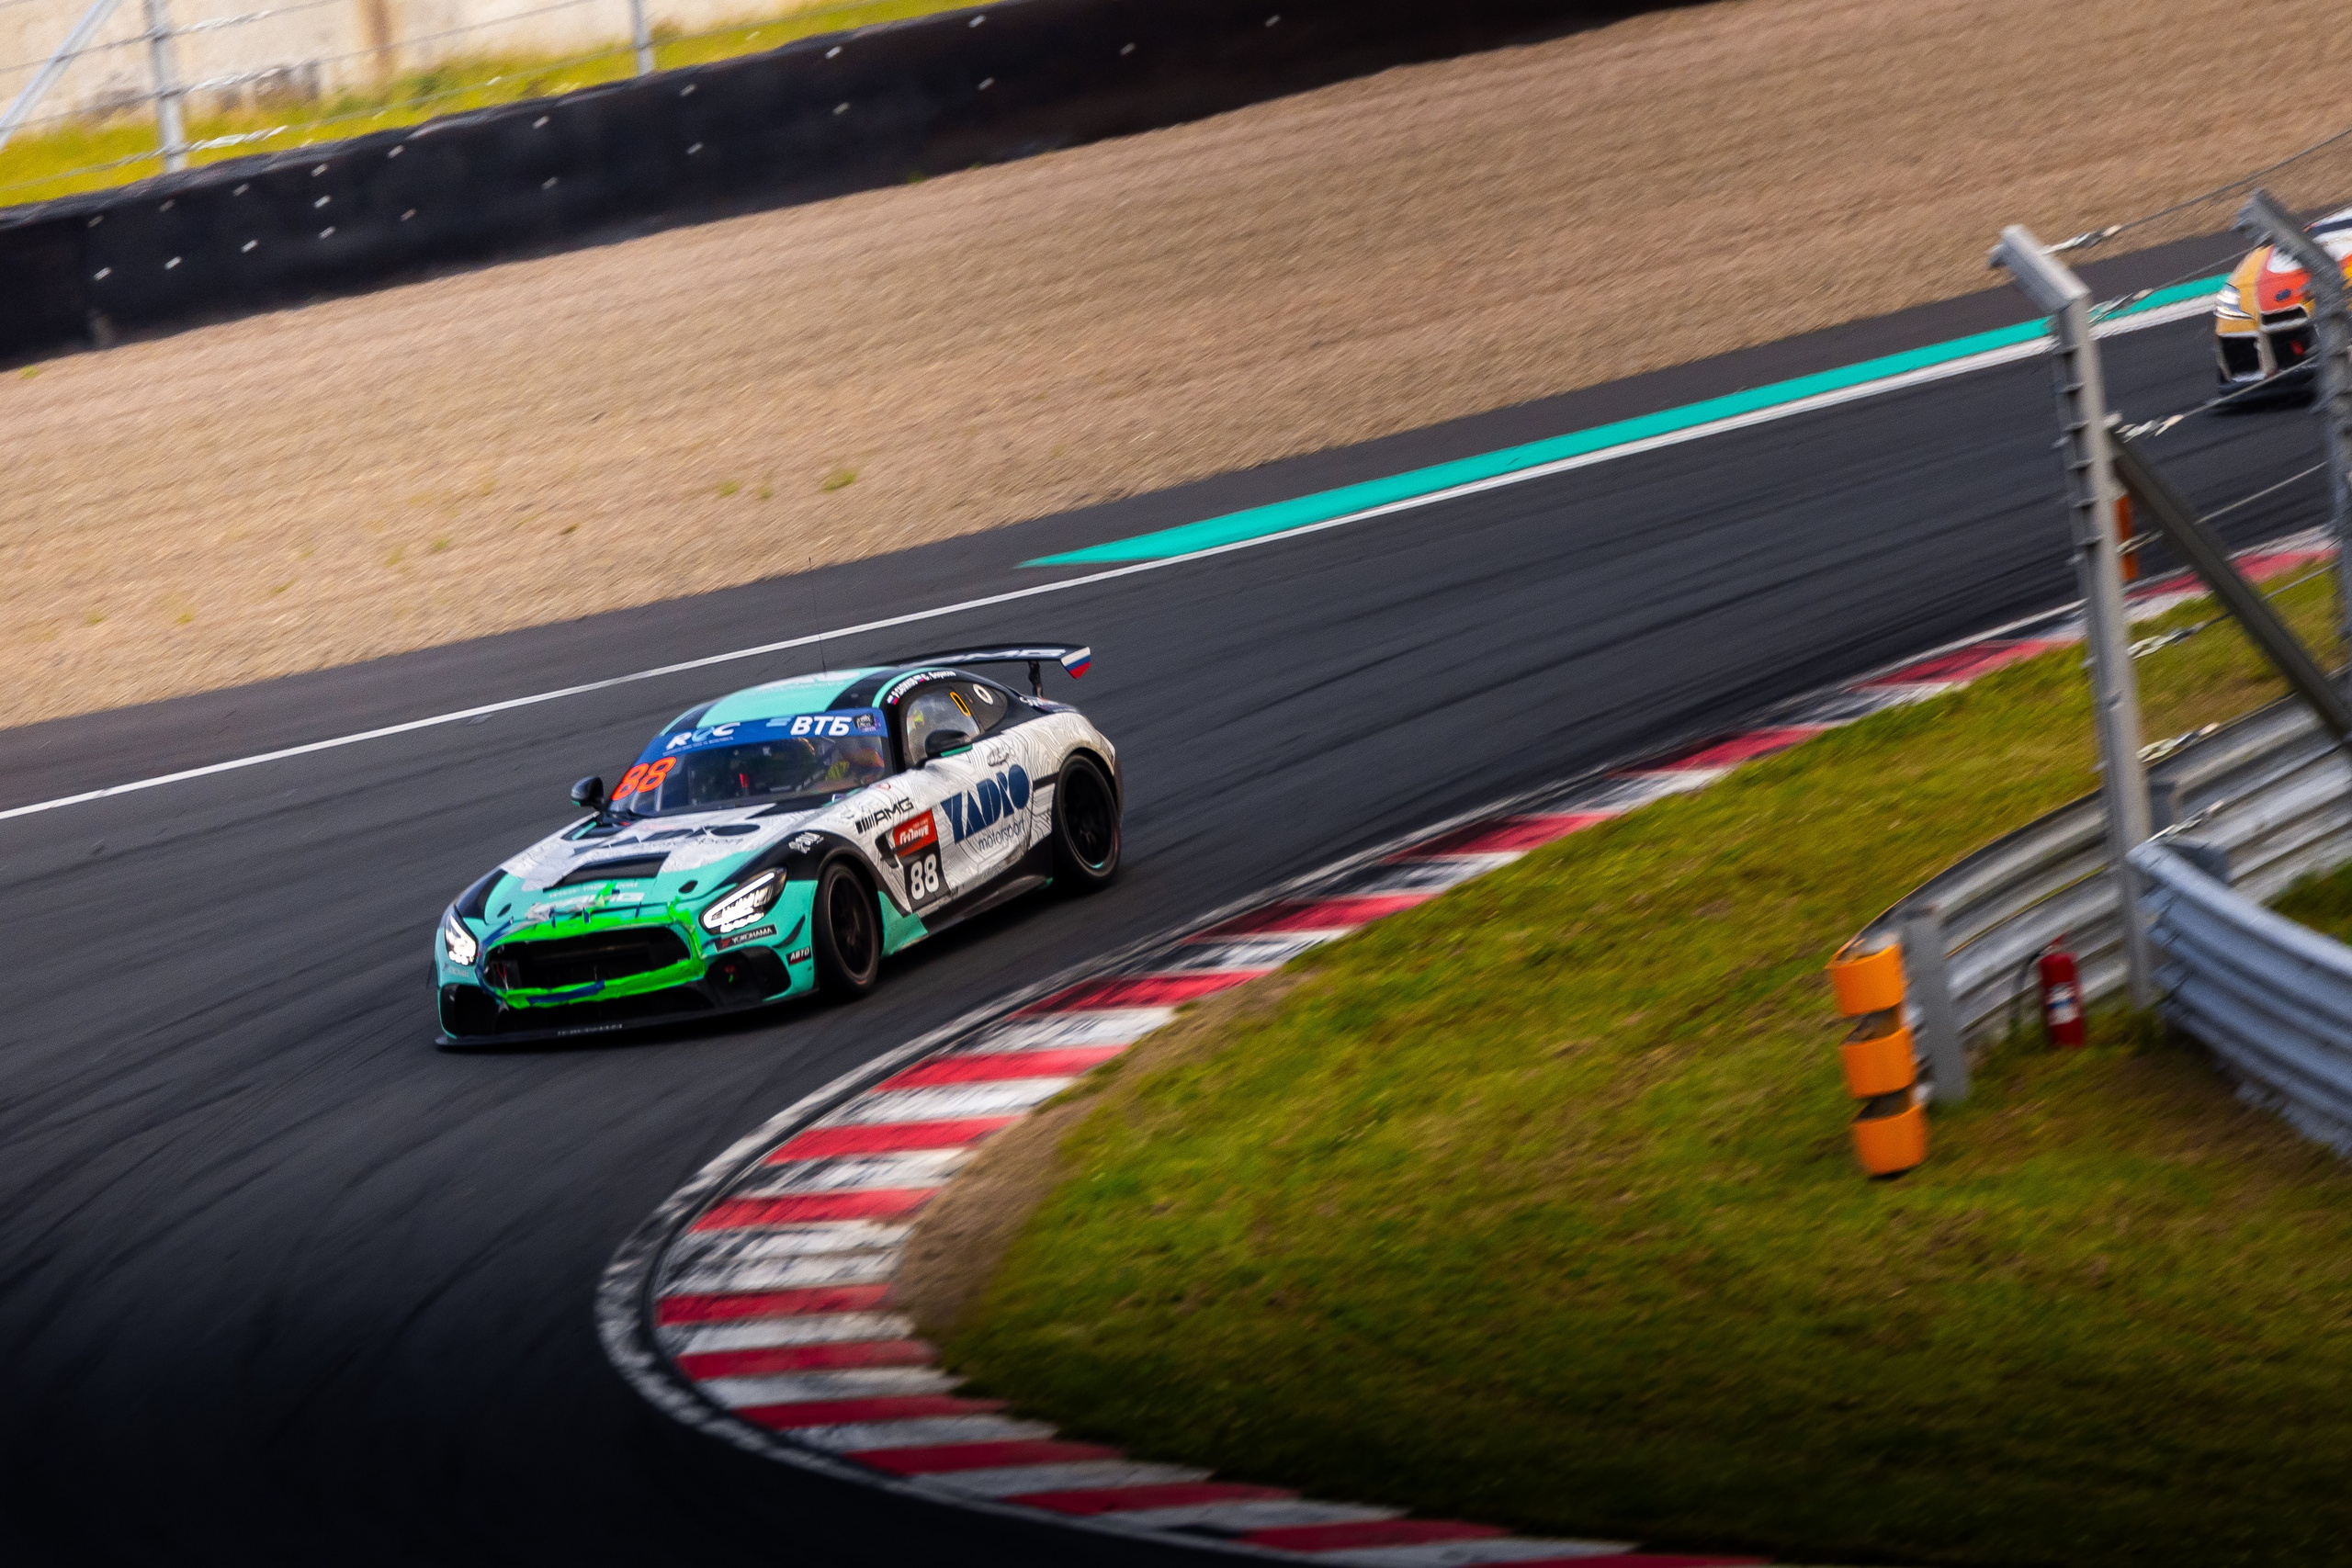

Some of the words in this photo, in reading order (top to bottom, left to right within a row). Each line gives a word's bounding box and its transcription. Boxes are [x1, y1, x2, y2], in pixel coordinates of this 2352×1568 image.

[790, 716, 853, 736] ВТБ
[611, 757, 677, 801] 88
[875, 797, 914, 827] AMG
[978, 818, 1026, 852] motorsport
[910, 853, 940, 900] 88
[731, 927, 773, 944] YOKOHAMA
